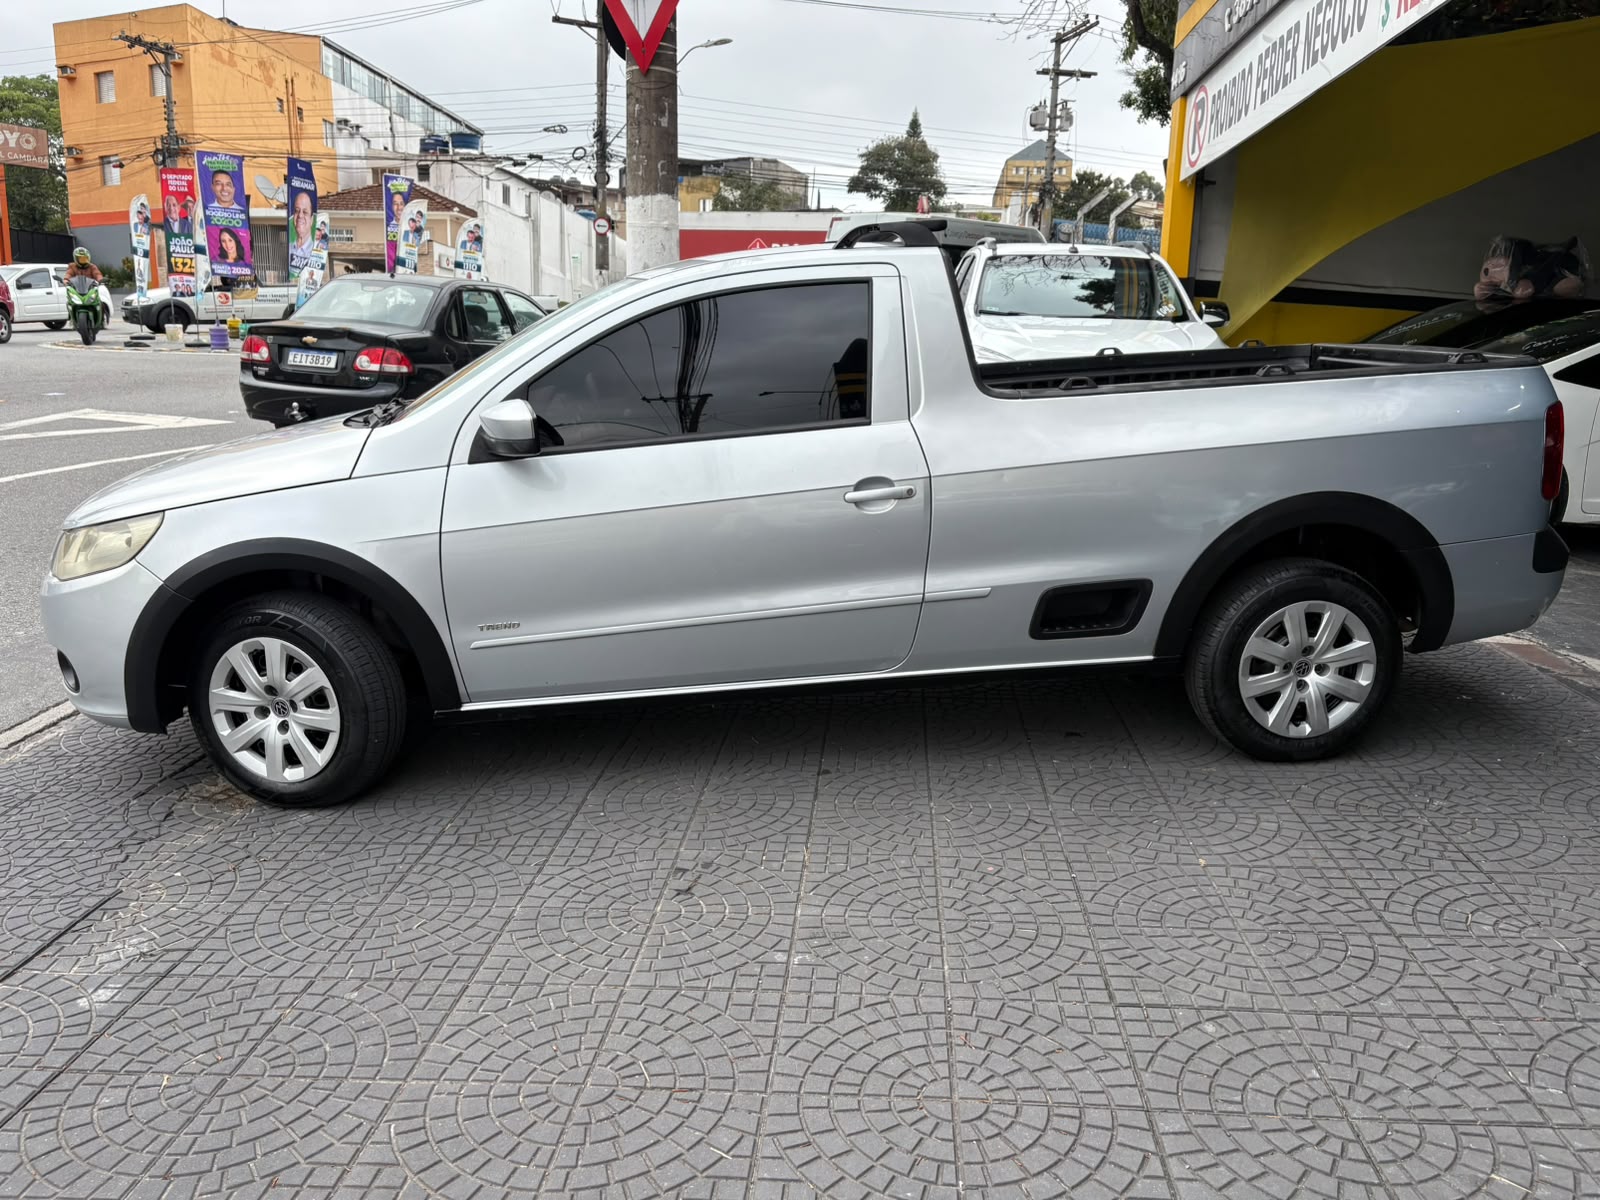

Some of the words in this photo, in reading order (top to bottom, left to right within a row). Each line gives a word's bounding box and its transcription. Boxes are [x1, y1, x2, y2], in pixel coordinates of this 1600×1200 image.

[1207, 61, 1253, 144] PROIBIDO
[1253, 20, 1301, 110] PERDER
[0, 129, 37, 150] YO
[170, 236, 193, 245] JOÃO
[292, 353, 332, 366] EIT3B19
[477, 621, 521, 632] TREND
